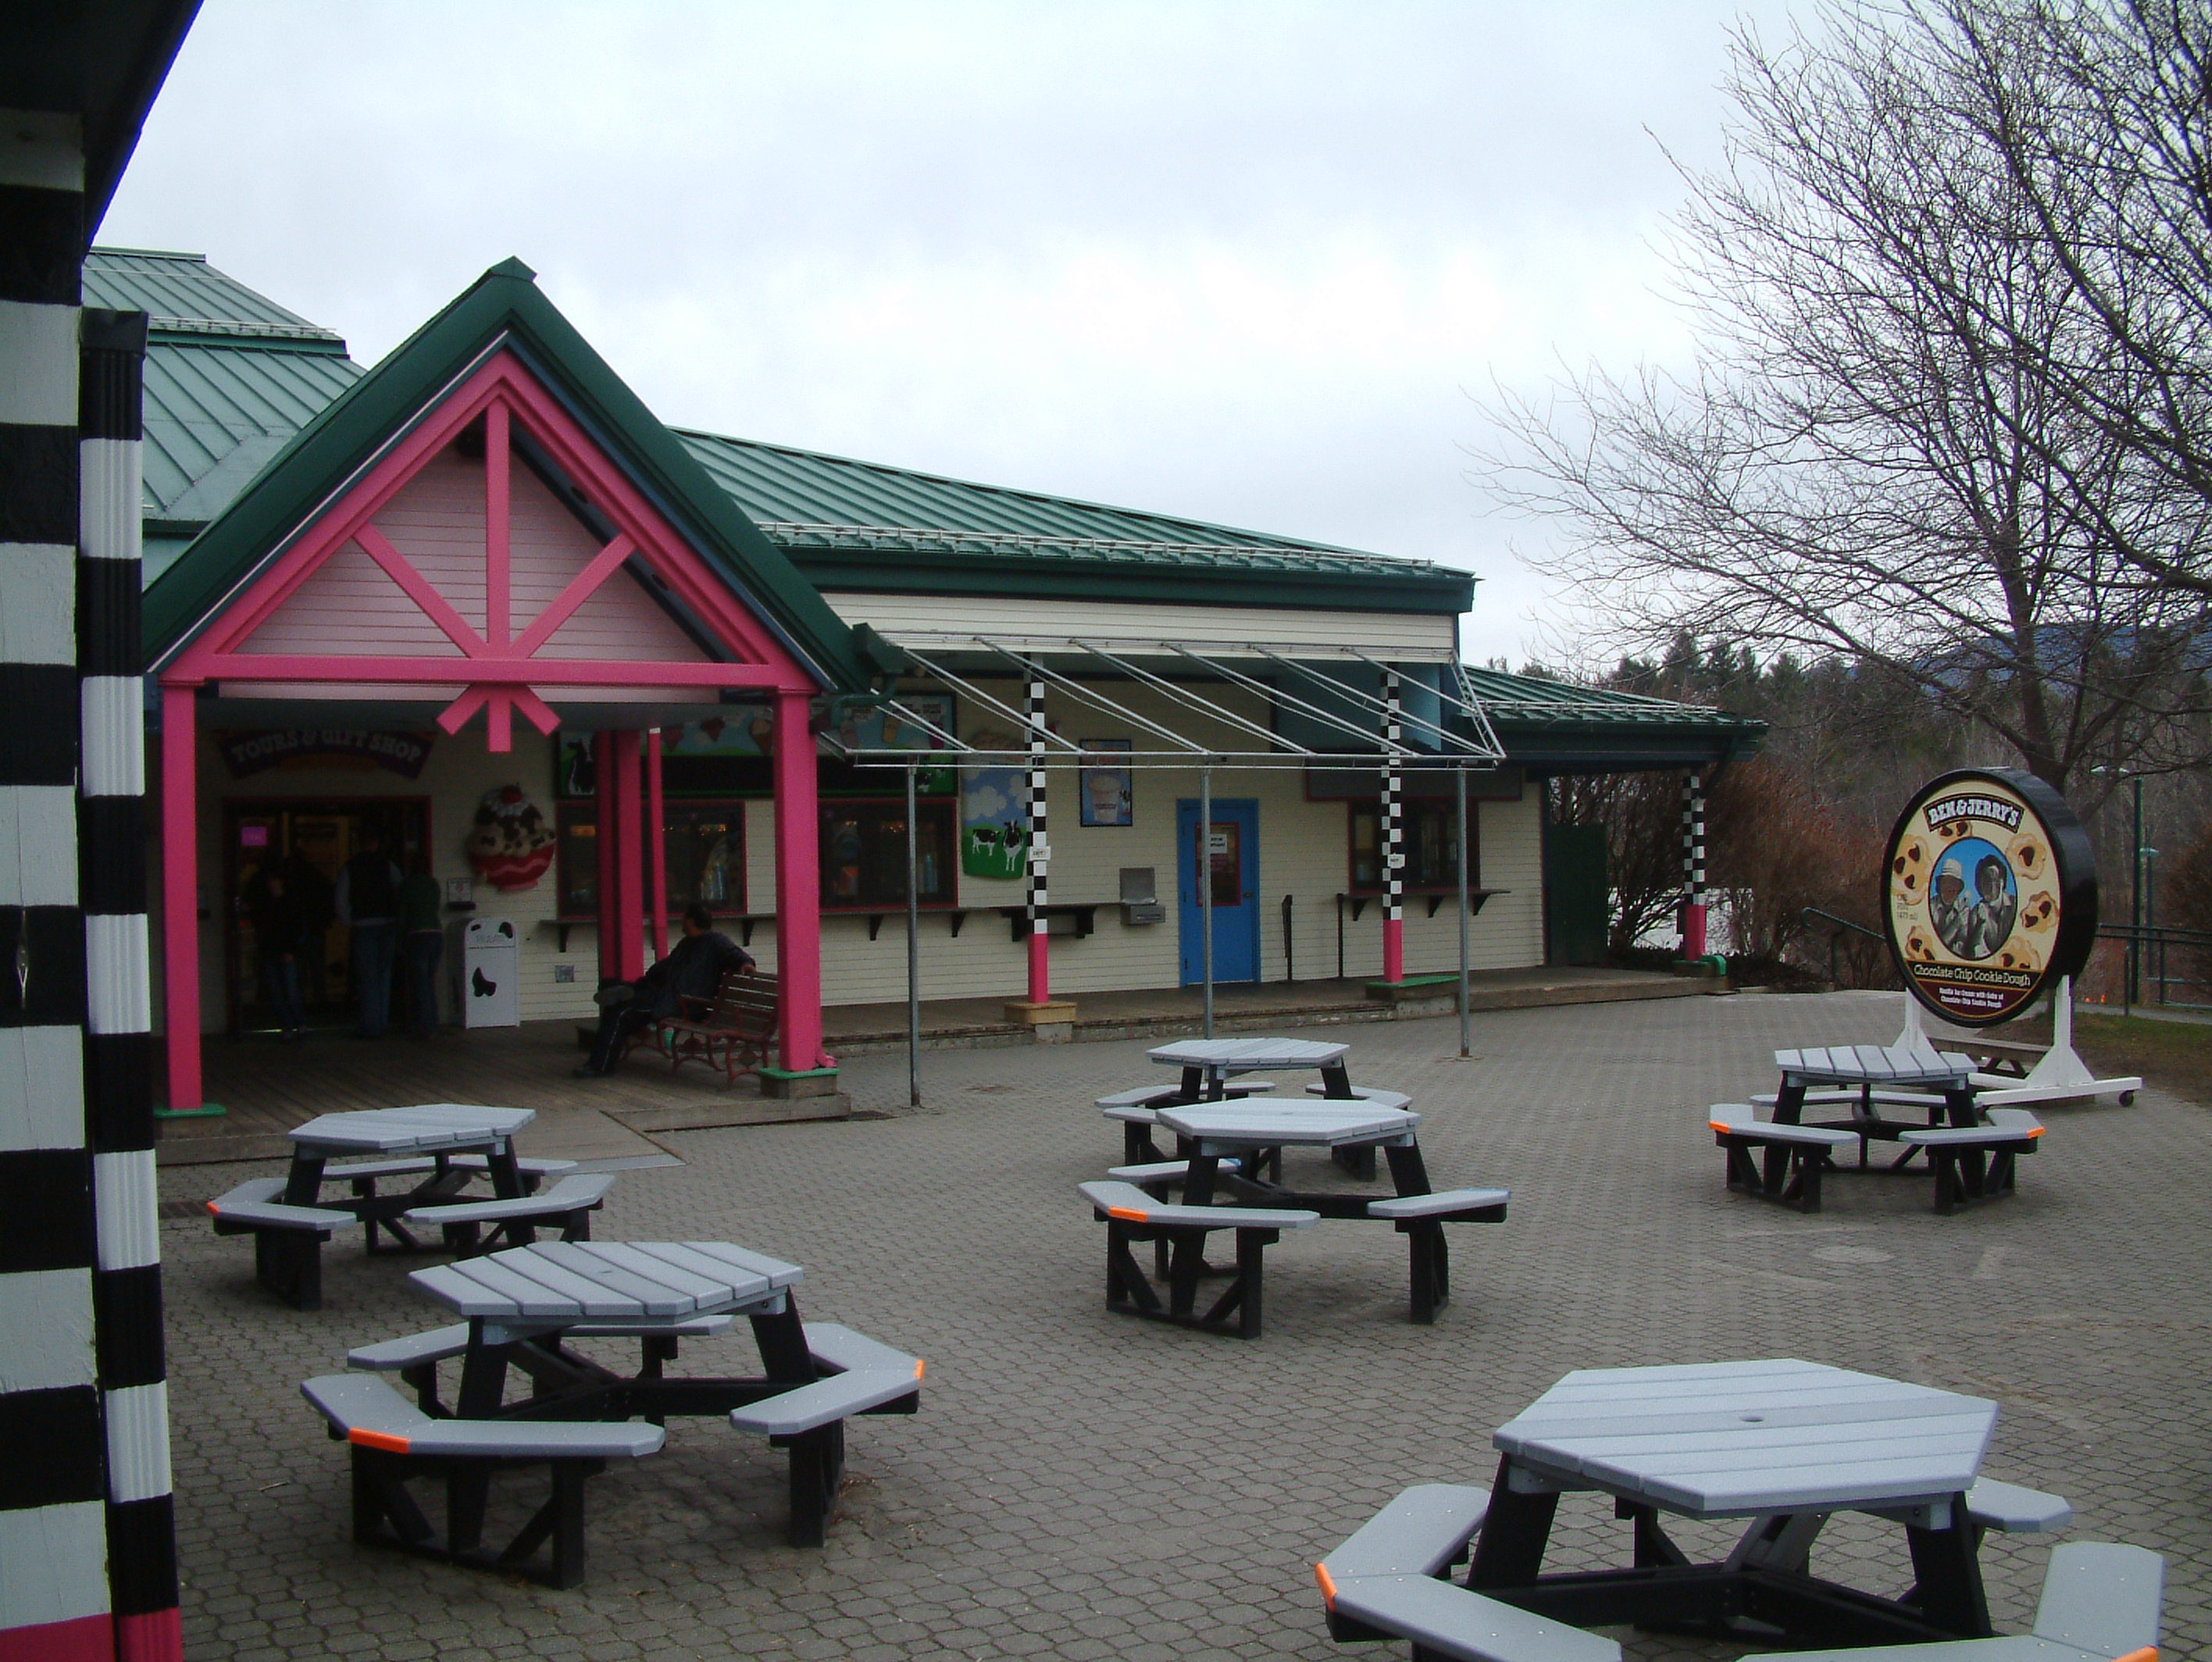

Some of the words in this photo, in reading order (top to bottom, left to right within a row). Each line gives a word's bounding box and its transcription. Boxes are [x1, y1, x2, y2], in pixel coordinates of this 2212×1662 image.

[231, 730, 300, 763] TOURS
[321, 730, 368, 747] GIFT
[369, 732, 422, 762] SHOP
[1914, 965, 1953, 978] Chocolate
[1954, 968, 1972, 982] Chip
[1974, 969, 2003, 983] Cookie
[2003, 972, 2030, 986] Dough
